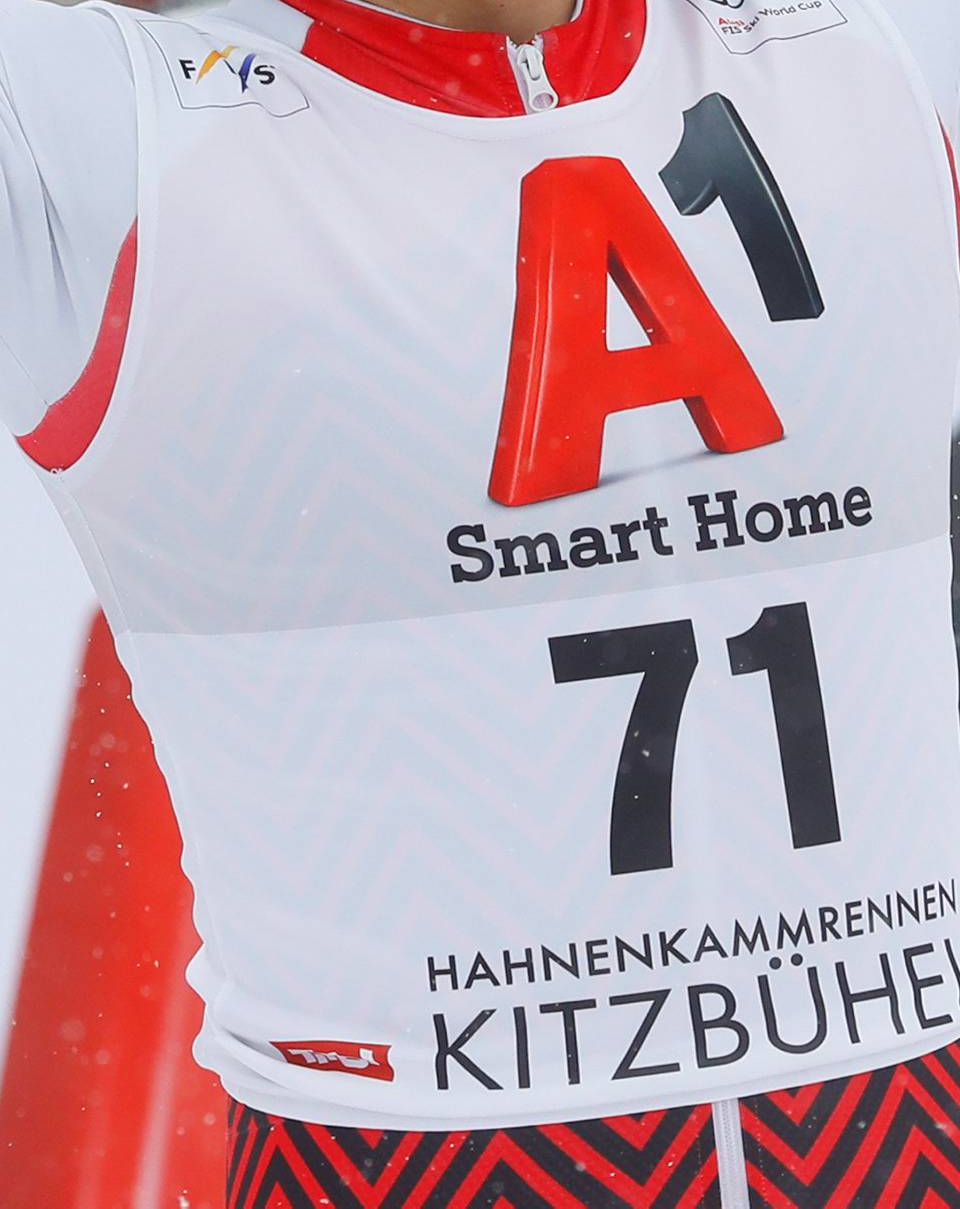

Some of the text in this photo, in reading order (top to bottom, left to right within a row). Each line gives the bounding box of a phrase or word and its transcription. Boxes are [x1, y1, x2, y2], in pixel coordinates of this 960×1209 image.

[797, 0, 822, 11] Cup
[487, 91, 825, 507] A1
[446, 484, 873, 583] Smart Home
[547, 601, 841, 875] 71
[427, 878, 958, 992] HAHNENKAMMRENNEN
